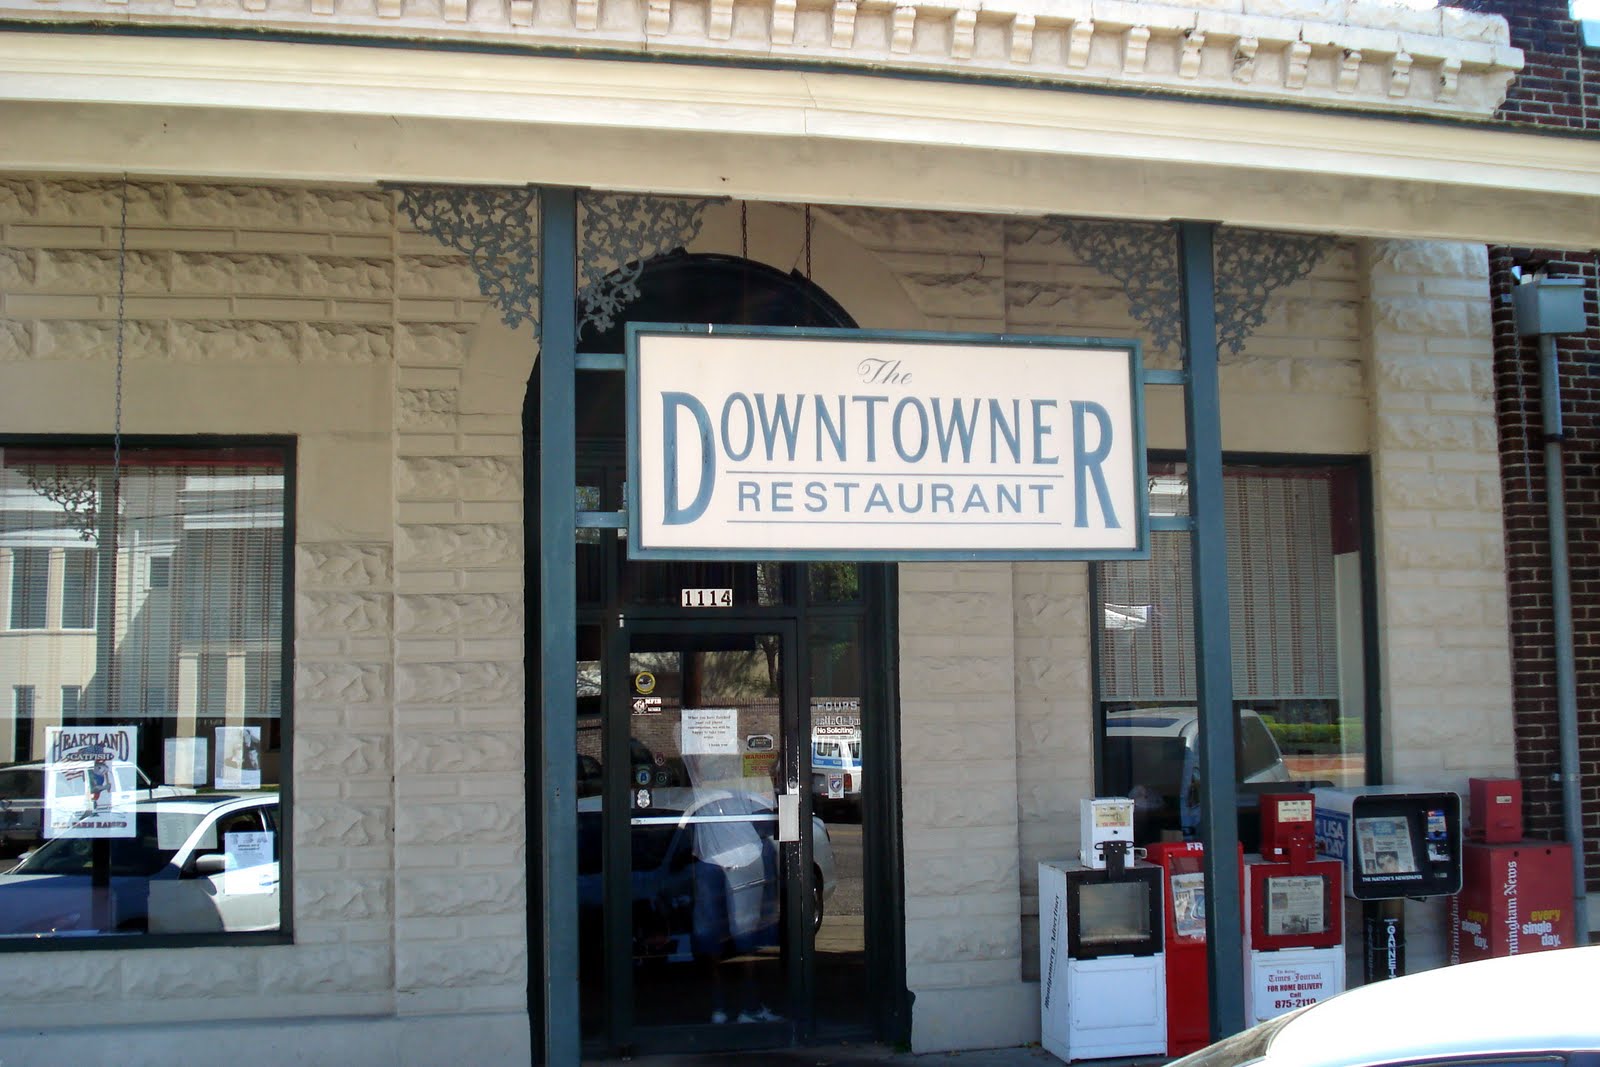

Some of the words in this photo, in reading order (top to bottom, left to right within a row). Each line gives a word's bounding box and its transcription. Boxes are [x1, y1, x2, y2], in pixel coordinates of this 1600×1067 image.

[857, 357, 913, 386] The
[660, 391, 1122, 529] DOWNTOWNER
[738, 481, 1054, 514] RESTAURANT
[684, 589, 732, 606] 1114
[817, 700, 858, 712] HOURS
[826, 727, 854, 735] Soliciting
[52, 730, 129, 762] HEARTLAND
[70, 753, 110, 761] CATFISH
[72, 821, 94, 829] FARM
[96, 821, 127, 829] RAISED
[1322, 819, 1345, 841] USA
[1504, 860, 1518, 896] News
[1531, 909, 1561, 922] every
[1461, 919, 1482, 935] single
[1522, 920, 1552, 935] single
[1541, 933, 1561, 947] day.
[1044, 947, 1056, 1009] Montgomery
[1267, 984, 1279, 992] FOR
[1280, 984, 1296, 992] HOME
[1297, 982, 1324, 991] DELIVERY
